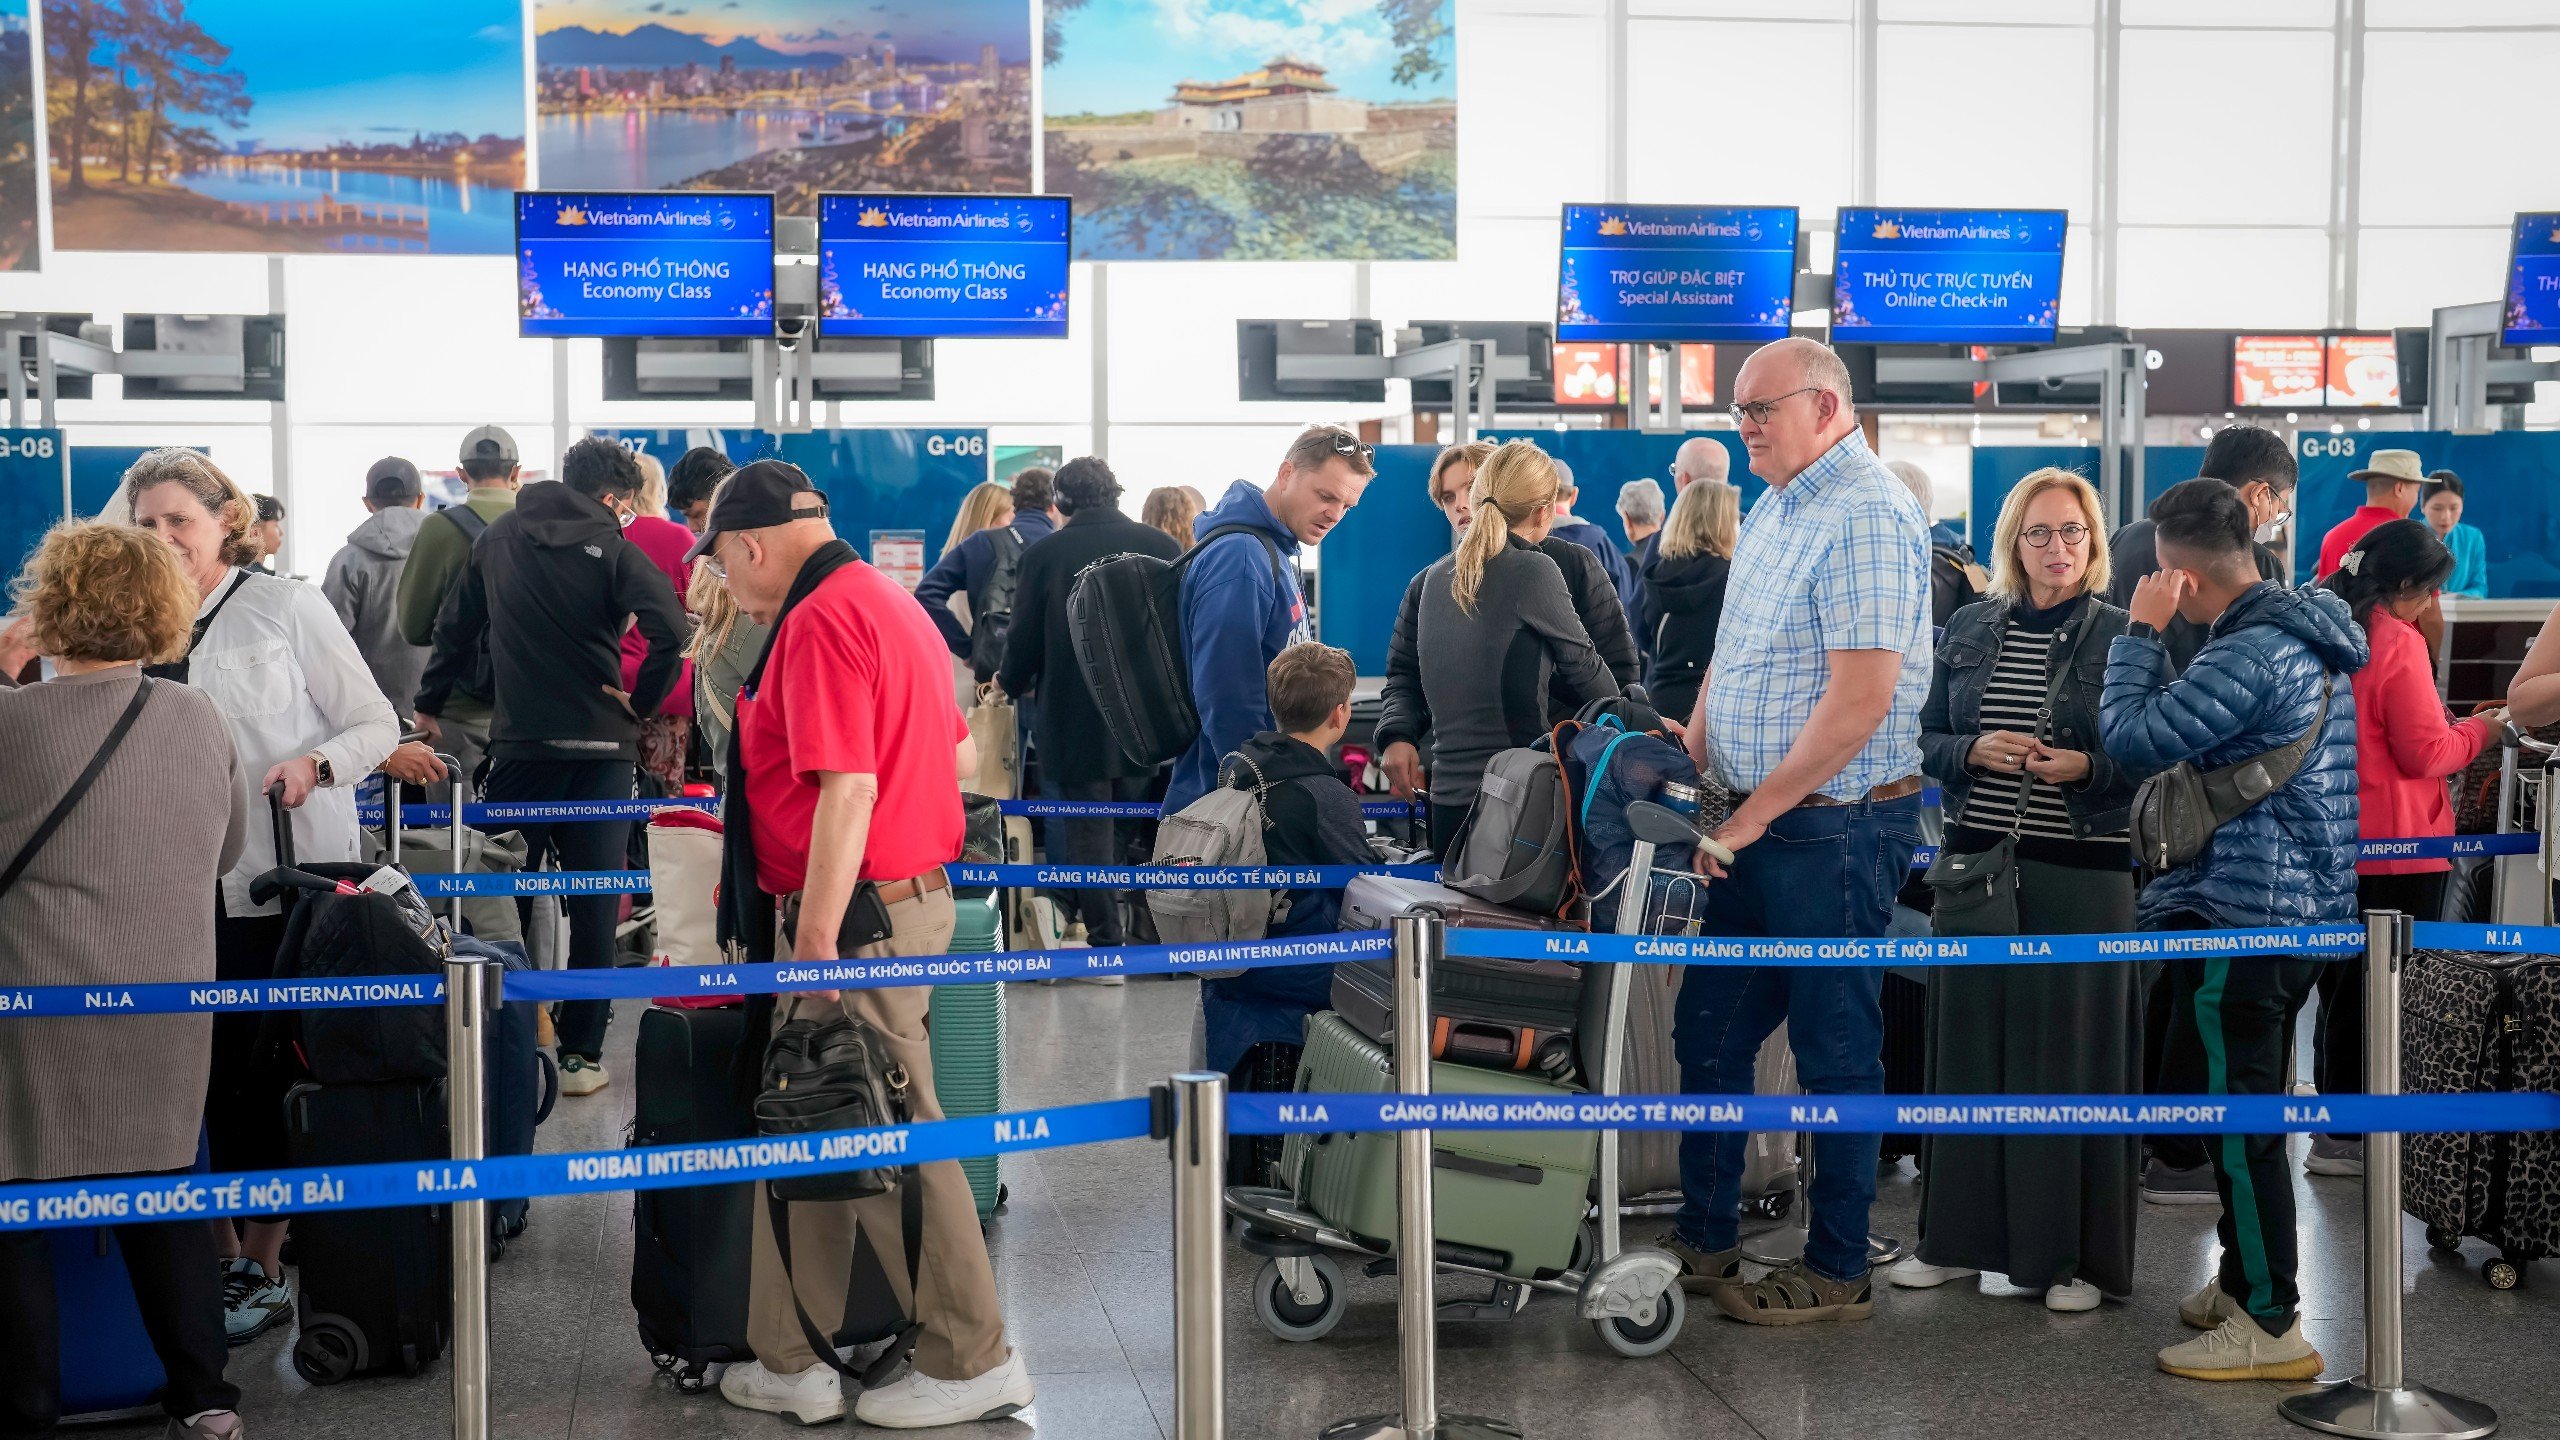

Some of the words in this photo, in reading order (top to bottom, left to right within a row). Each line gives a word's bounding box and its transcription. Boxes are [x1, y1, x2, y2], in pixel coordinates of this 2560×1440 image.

[588, 211, 652, 226] Vietnam
[654, 211, 711, 226] Airlines
[888, 213, 951, 227] Vietnam
[952, 214, 1009, 228] Airlines
[1628, 222, 1686, 236] Vietnam
[1688, 223, 1740, 236] Airlines
[1901, 225, 1958, 239] Vietnam
[1959, 226, 2010, 239] Airlines
[563, 261, 617, 281] HẠNG
[664, 259, 730, 278] THÔNG
[863, 262, 916, 282] HẠNG
[962, 261, 1026, 280] THÔNG
[1610, 270, 1640, 287] TRỢ
[1715, 269, 1745, 288] BIỆT
[1863, 269, 1897, 287] THỦ
[1901, 272, 1932, 291] TỤC
[1935, 271, 1977, 291] TRỰC
[1981, 269, 2033, 289] TUYẾN
[2538, 275, 2560, 291] TH
[583, 282, 663, 302] Economy
[668, 282, 711, 299] Class
[881, 283, 961, 303] Economy
[965, 283, 1007, 300] Class
[1619, 289, 1668, 307] Special
[1671, 290, 1734, 305] Assistant
[1885, 291, 1937, 308] Online
[1941, 292, 2008, 308] Check-in
[0, 437, 54, 458] G-08
[927, 435, 984, 456] G-06
[2302, 438, 2355, 457] G-03
[487, 808, 525, 818] NOIBAI
[527, 805, 614, 816] INTERNATIONAL
[2362, 842, 2419, 855] AIRPORT
[2453, 841, 2484, 853] N.I.A
[963, 870, 998, 881] N.I.A
[1037, 865, 1082, 883] CẢNG
[1086, 867, 1131, 883] HÀNG
[1135, 867, 1189, 884] KHÔNG
[1193, 866, 1238, 885] QUỐC
[1241, 866, 1261, 884] TẾ
[1265, 867, 1291, 887] NỘI
[1295, 868, 1321, 884] BÀI
[440, 880, 475, 891] N.I.A
[515, 879, 566, 891] NOIBAI
[1546, 939, 1589, 953] N.I.A
[2098, 939, 2159, 955] NOIBAI
[2164, 933, 2302, 954] INTERNATIONAL
[2487, 931, 2522, 945] N.I.A
[1169, 946, 1222, 964] NOIBAI
[1226, 941, 1348, 961] INTERNATIONAL
[1635, 937, 1687, 957] CẢNG
[1692, 941, 1743, 957] HÀNG
[1750, 941, 1813, 958] KHÔNG
[1818, 938, 1869, 958] QUỐC
[1875, 939, 1897, 957] TẾ
[1902, 941, 1932, 961] NỘI
[1938, 941, 1967, 957] BÀI
[2010, 942, 2051, 955] N.I.A
[777, 968, 819, 982] CẢNG
[824, 966, 866, 980] HÀNG
[870, 963, 923, 978] KHÔNG
[997, 959, 1022, 974] NỘI
[1026, 956, 1050, 970] BÀI
[1088, 955, 1123, 967] N.I.A
[700, 973, 737, 986] N.I.A
[0, 992, 32, 1010] BÀI
[86, 992, 134, 1007] N.I.A
[190, 988, 258, 1005] NOIBAI
[269, 983, 424, 1003] INTERNATIONAL
[1279, 1105, 1328, 1122] N.I.A
[1380, 1101, 1437, 1121] CẢNG
[1442, 1101, 1499, 1121] HÀNG
[1504, 1102, 1575, 1121] KHÔNG
[1671, 1104, 1705, 1124] NỘI
[1710, 1103, 1743, 1121] BÀI
[1791, 1106, 1838, 1122] N.I.A
[1898, 1107, 1968, 1123] NOIBAI
[1972, 1106, 2133, 1123] INTERNATIONAL
[2136, 1106, 2226, 1122] AIRPORT
[2284, 1106, 2330, 1122] N.I.A
[995, 1117, 1049, 1142] N.I.A
[565, 1151, 642, 1180] NOIBAI
[648, 1140, 815, 1175] INTERNATIONAL
[820, 1130, 909, 1160] AIRPORT
[417, 1167, 477, 1191] N.I.A
[38, 1189, 128, 1220] KHÔNG
[135, 1181, 206, 1215] QUỐC
[212, 1179, 243, 1209] TẾ
[249, 1178, 291, 1211] NỘI
[303, 1174, 343, 1203] BÀI
